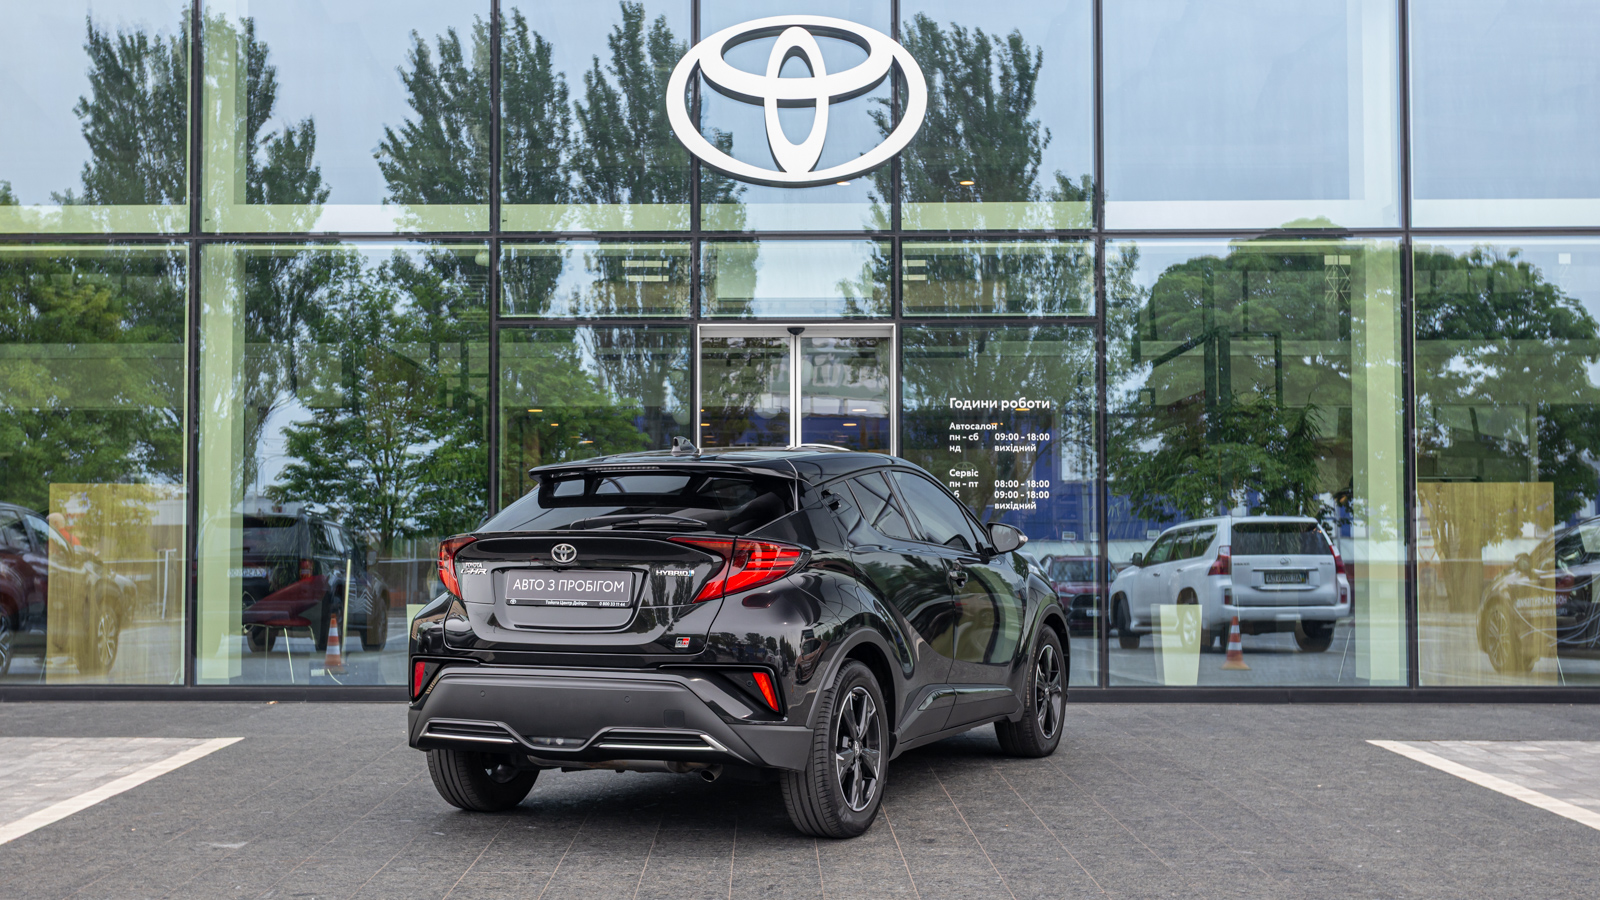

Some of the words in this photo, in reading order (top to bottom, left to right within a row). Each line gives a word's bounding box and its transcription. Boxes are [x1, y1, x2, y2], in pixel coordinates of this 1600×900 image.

[949, 397, 998, 410] Години
[1001, 397, 1050, 411] роботи
[949, 422, 998, 430] Автосалон
[968, 433, 979, 441] сб
[994, 433, 1019, 441] 09:00
[1026, 433, 1050, 441] 18:00
[949, 445, 961, 453] нд
[994, 444, 1037, 453] вихідний
[949, 469, 979, 478] Сервіс
[994, 480, 1019, 488] 08:00
[1026, 480, 1050, 488] 18:00
[994, 490, 1019, 499] 09:00
[1026, 490, 1050, 499] 18:00
[994, 501, 1037, 511] вихідний
[656, 569, 689, 577] HYBRID
[513, 579, 545, 591] АВТО
[558, 579, 625, 593] ПРОБІГОМ
